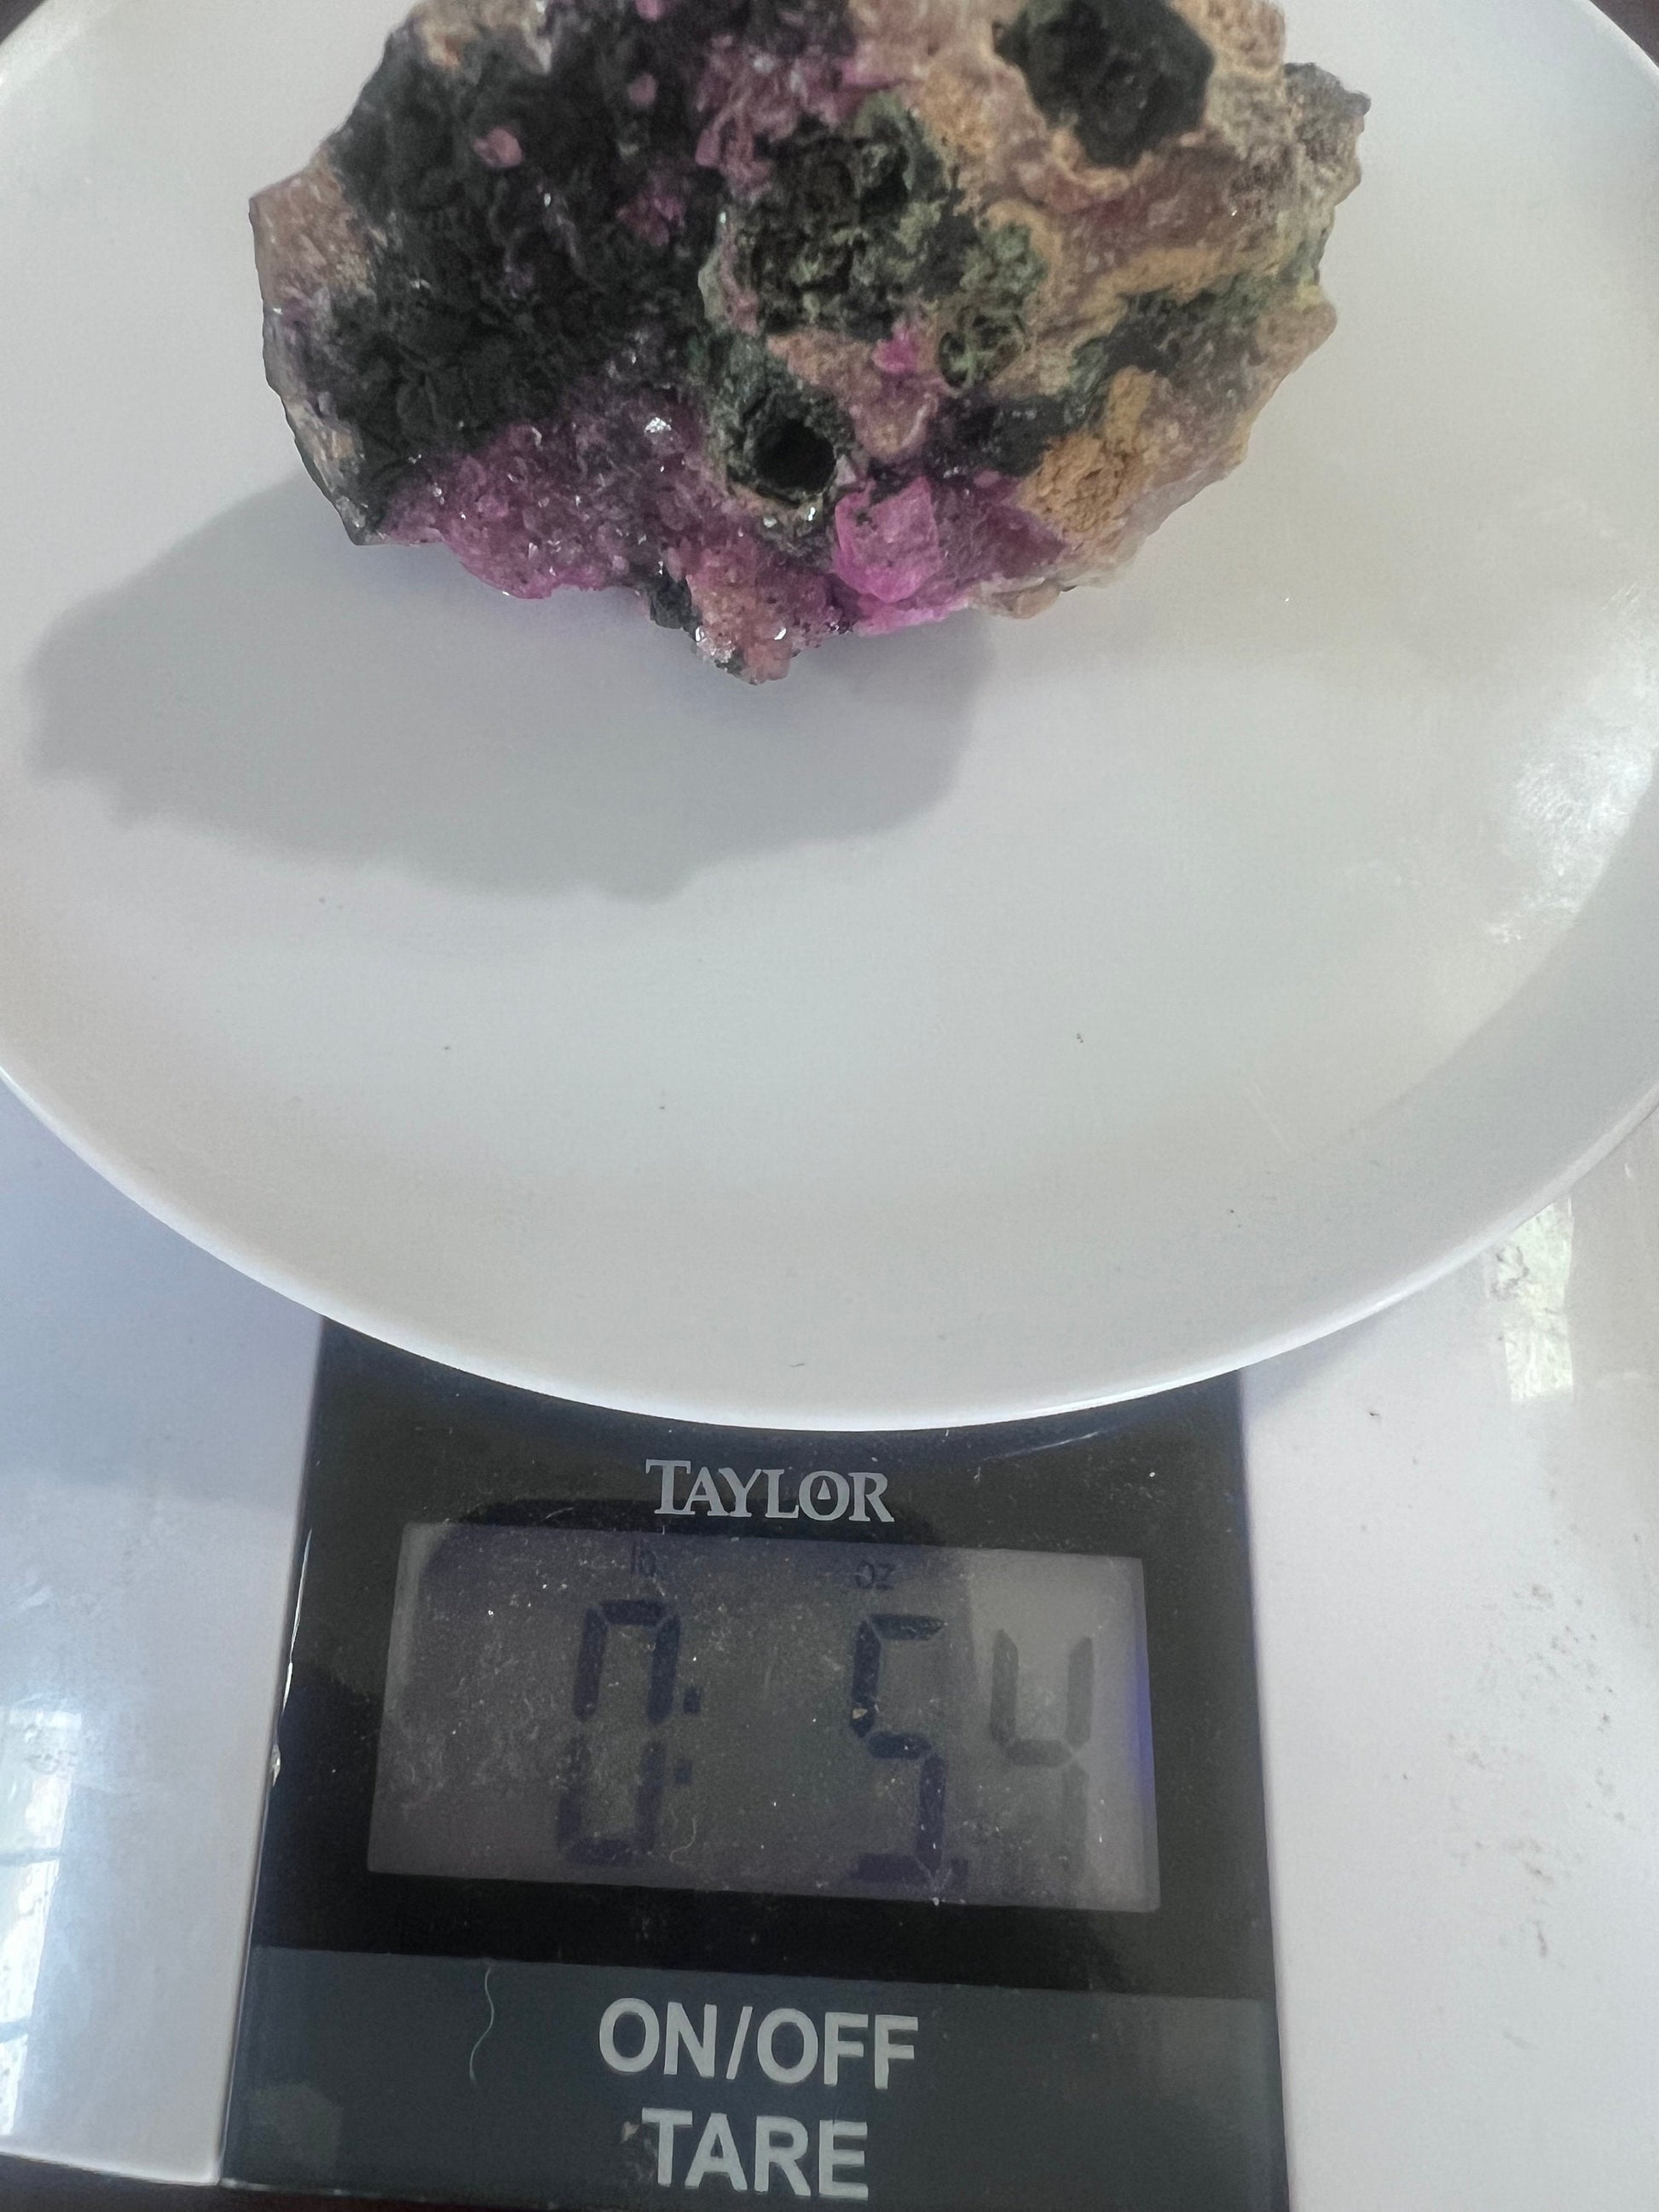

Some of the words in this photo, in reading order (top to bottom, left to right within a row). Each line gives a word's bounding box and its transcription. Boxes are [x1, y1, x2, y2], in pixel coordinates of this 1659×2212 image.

[645, 1458, 894, 1522] TAYLOR
[599, 1997, 918, 2089] ON/OFF
[641, 2107, 869, 2200] TARE
